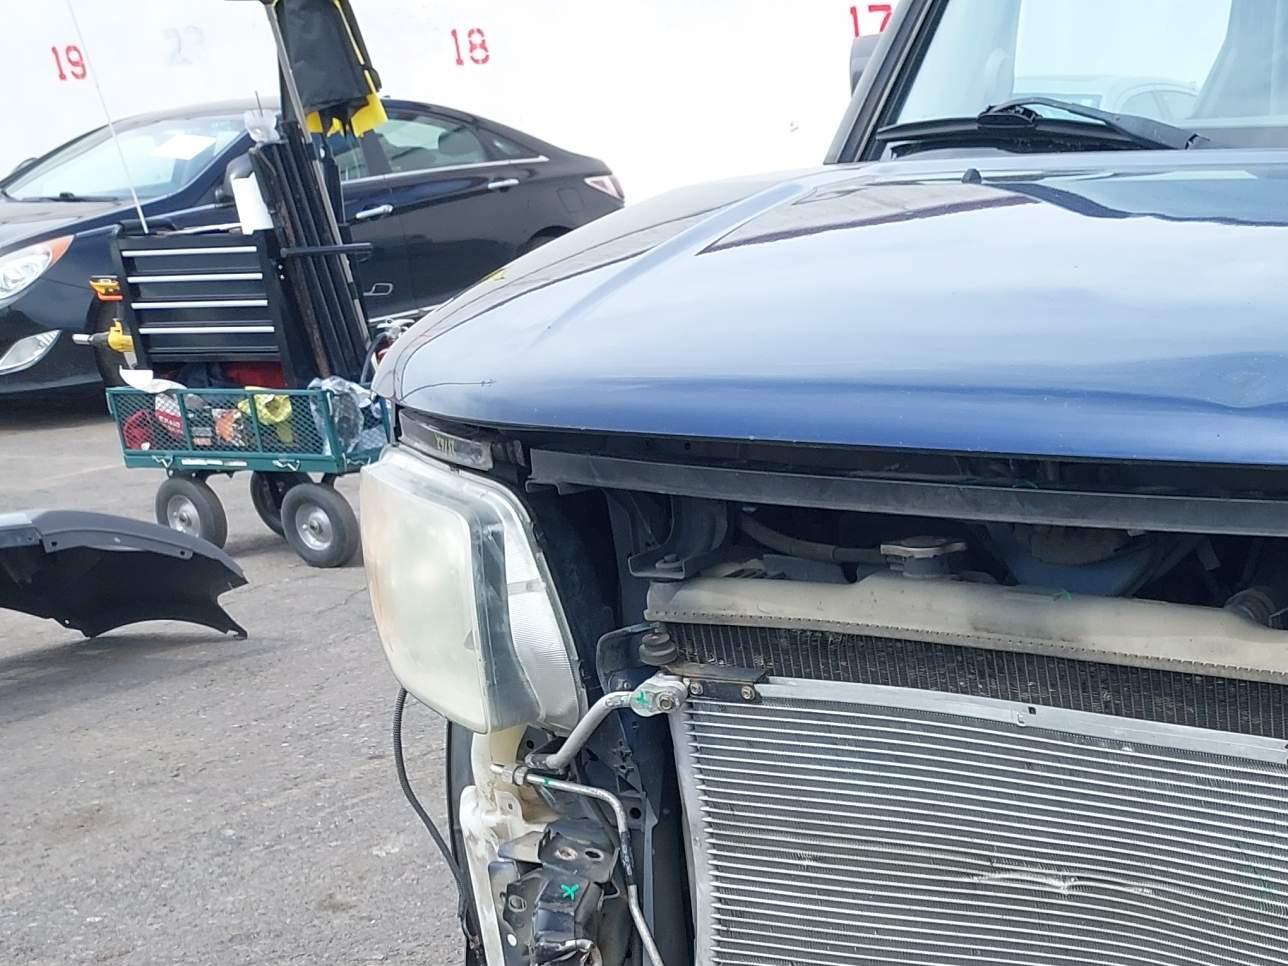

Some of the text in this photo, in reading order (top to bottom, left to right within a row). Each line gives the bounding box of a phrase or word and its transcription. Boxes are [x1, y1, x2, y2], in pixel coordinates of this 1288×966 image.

[849, 4, 892, 38] 17
[51, 45, 87, 80] 19
[451, 28, 489, 66] 18
